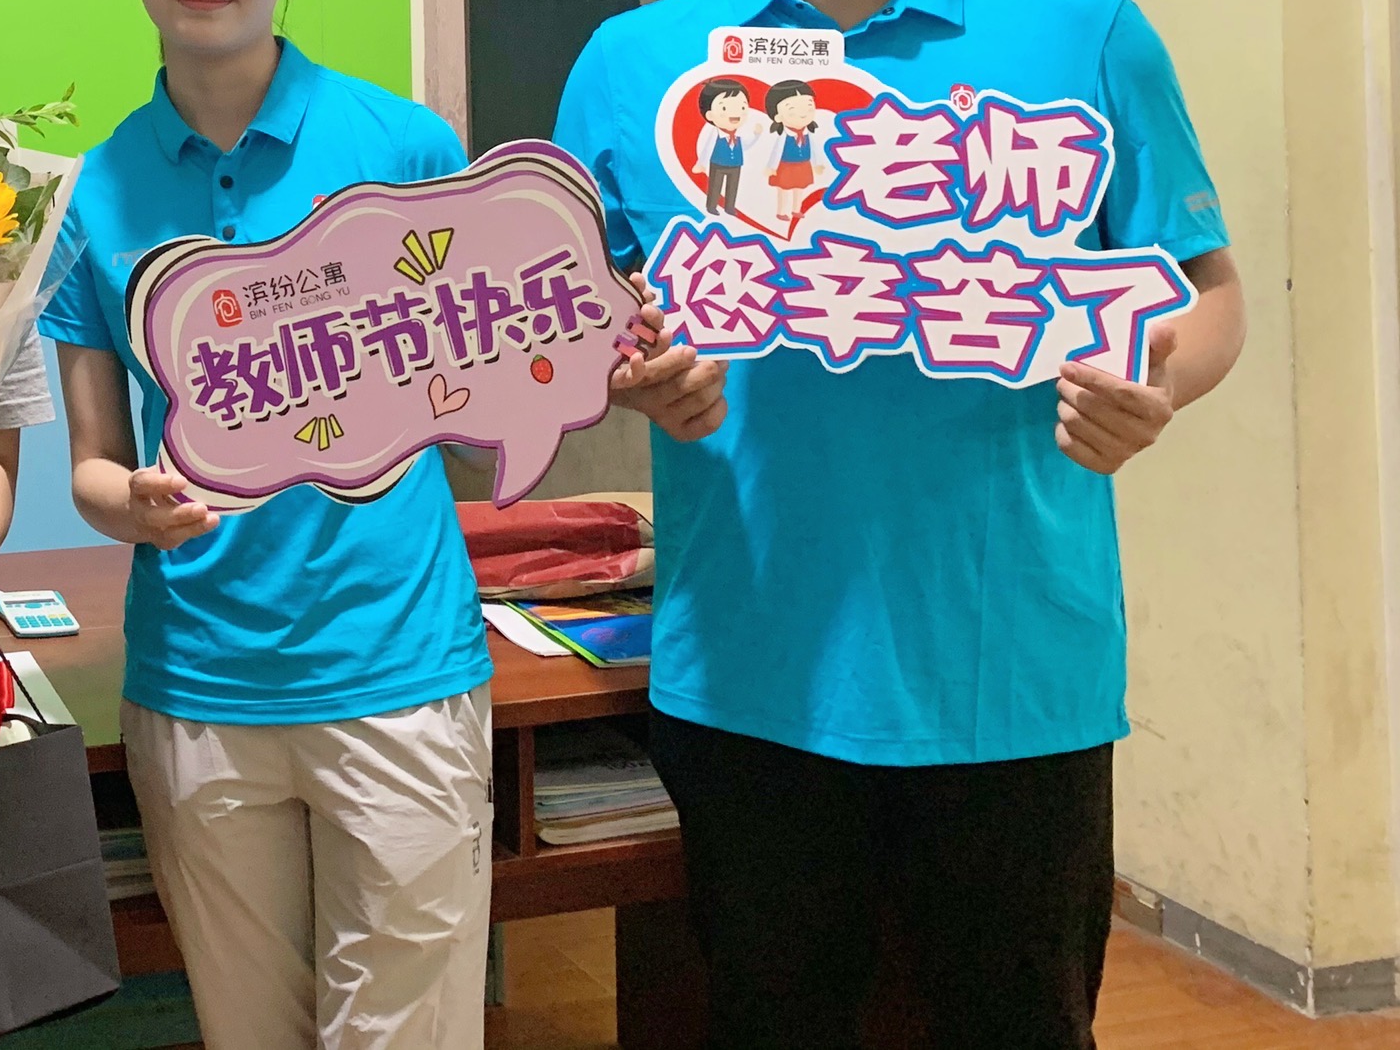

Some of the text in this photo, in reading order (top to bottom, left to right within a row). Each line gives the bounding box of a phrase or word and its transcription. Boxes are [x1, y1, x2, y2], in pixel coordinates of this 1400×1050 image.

[748, 56, 830, 67] BIN FEN GONG YU
[749, 37, 830, 56] 滨纷公寓
[833, 98, 1102, 229] 老师
[242, 261, 346, 308] 滨纷公寓
[249, 285, 351, 320] BIN FEN GONG YU
[653, 230, 1184, 381] 您辛苦了
[190, 249, 609, 426] 教师节快乐
